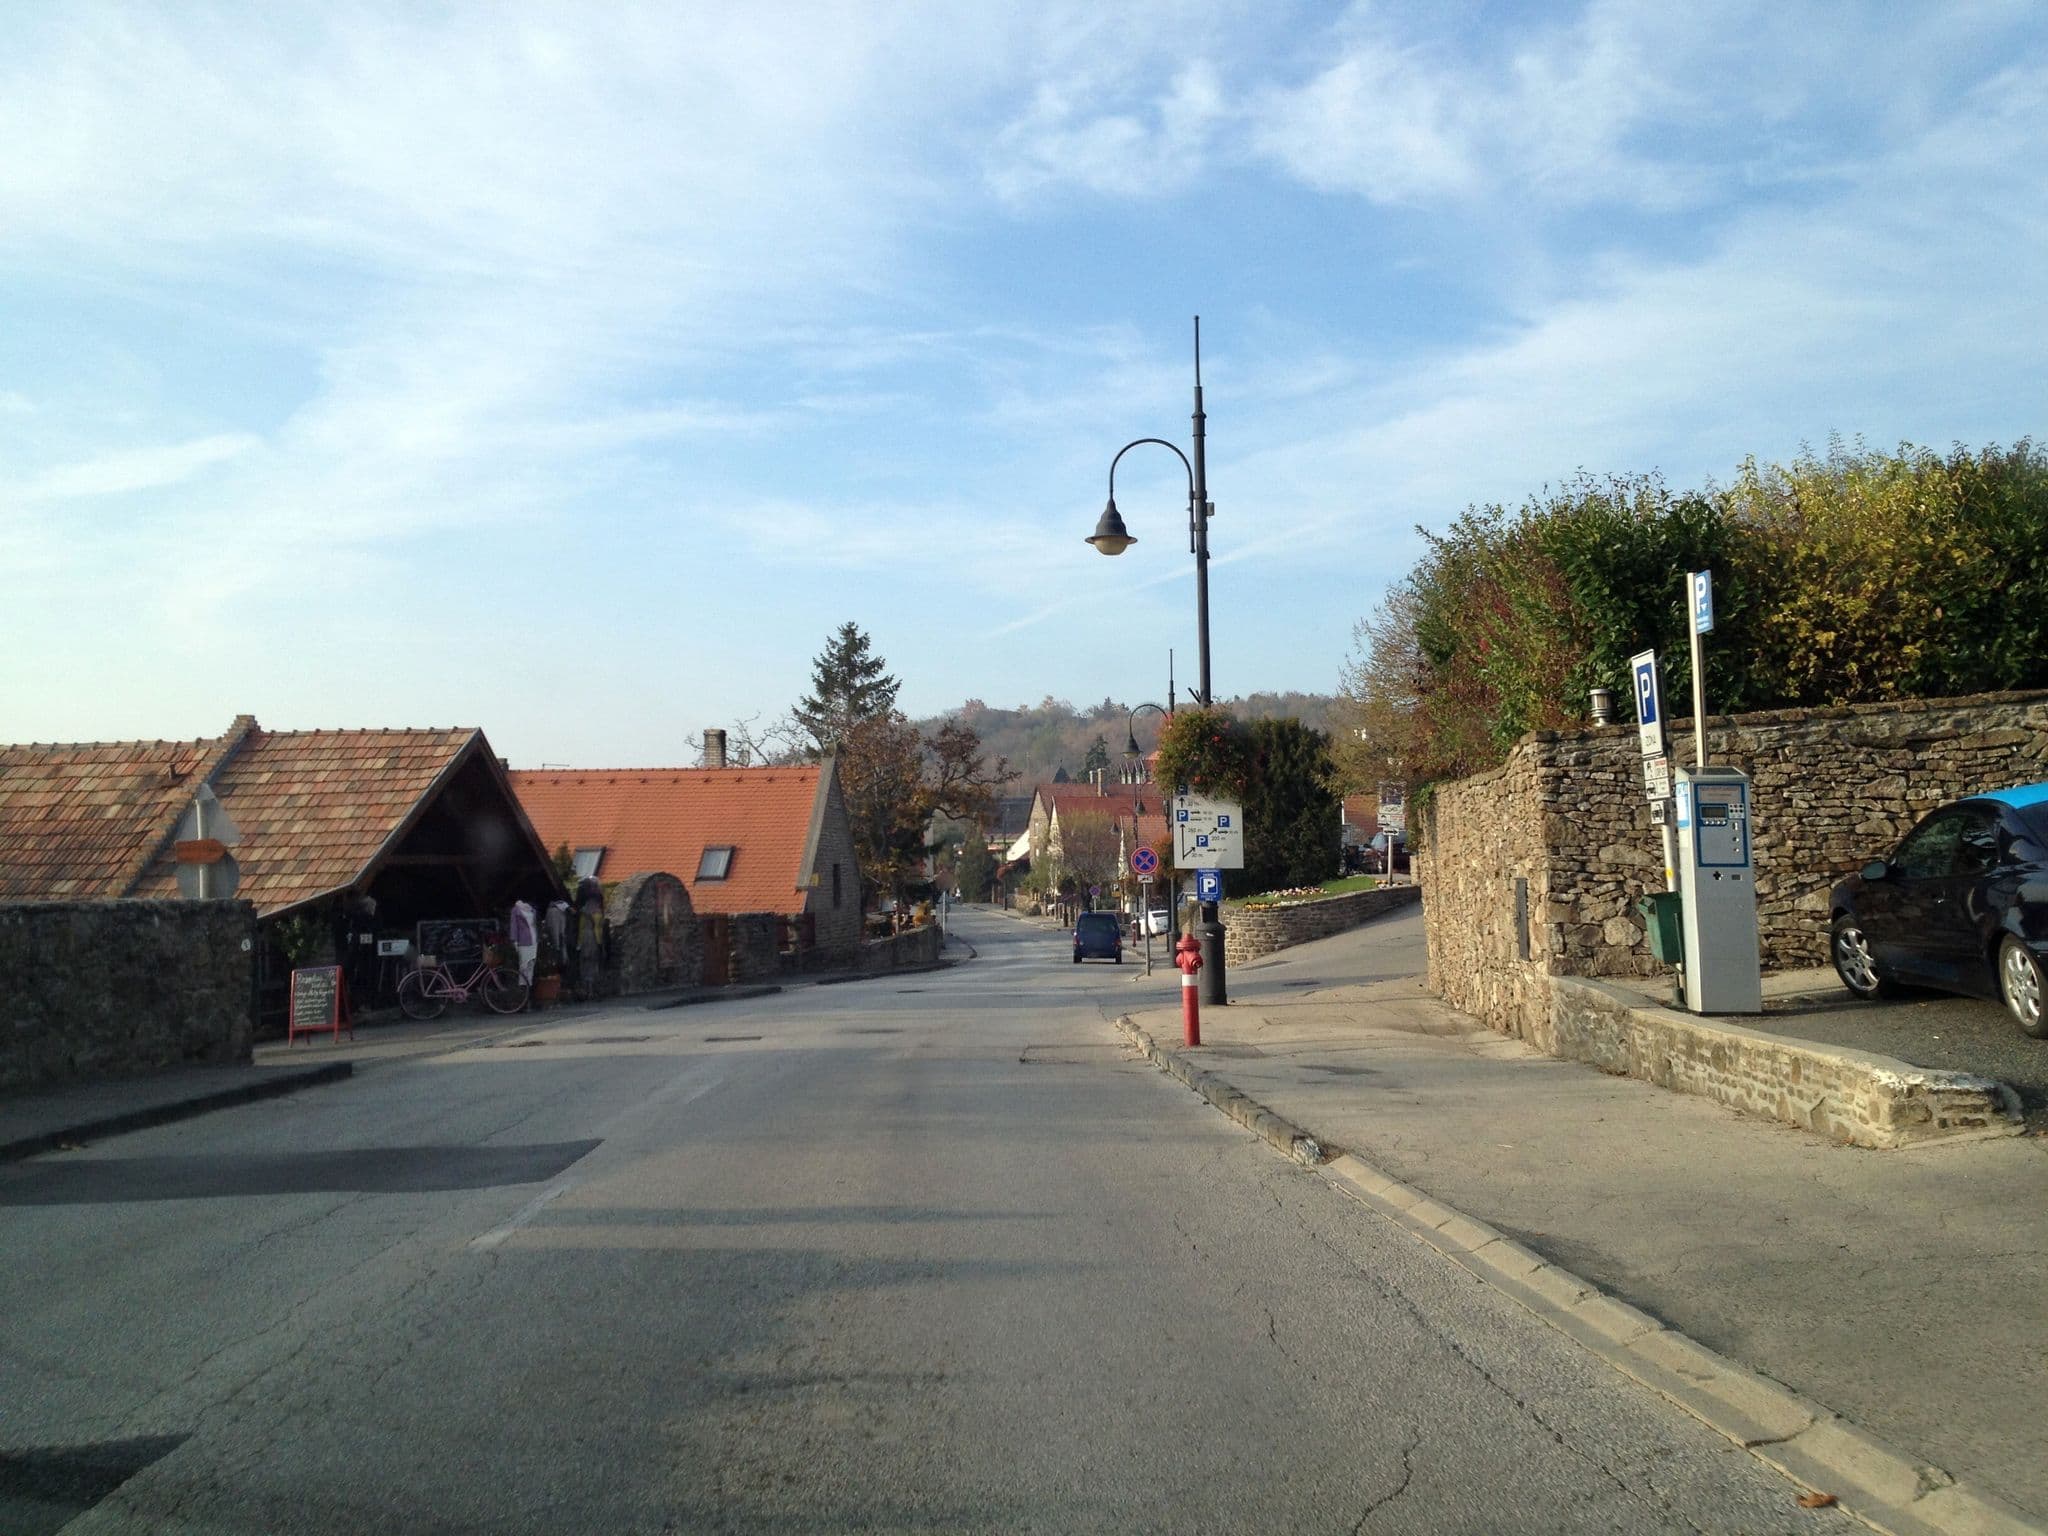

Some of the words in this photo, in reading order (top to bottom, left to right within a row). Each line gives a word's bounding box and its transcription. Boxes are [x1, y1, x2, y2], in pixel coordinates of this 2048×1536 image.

[1695, 575, 1707, 614] P
[1640, 672, 1650, 717] P
[1178, 811, 1186, 820] P
[1219, 817, 1228, 827] P
[1198, 836, 1206, 846] P
[1203, 878, 1216, 893] P
